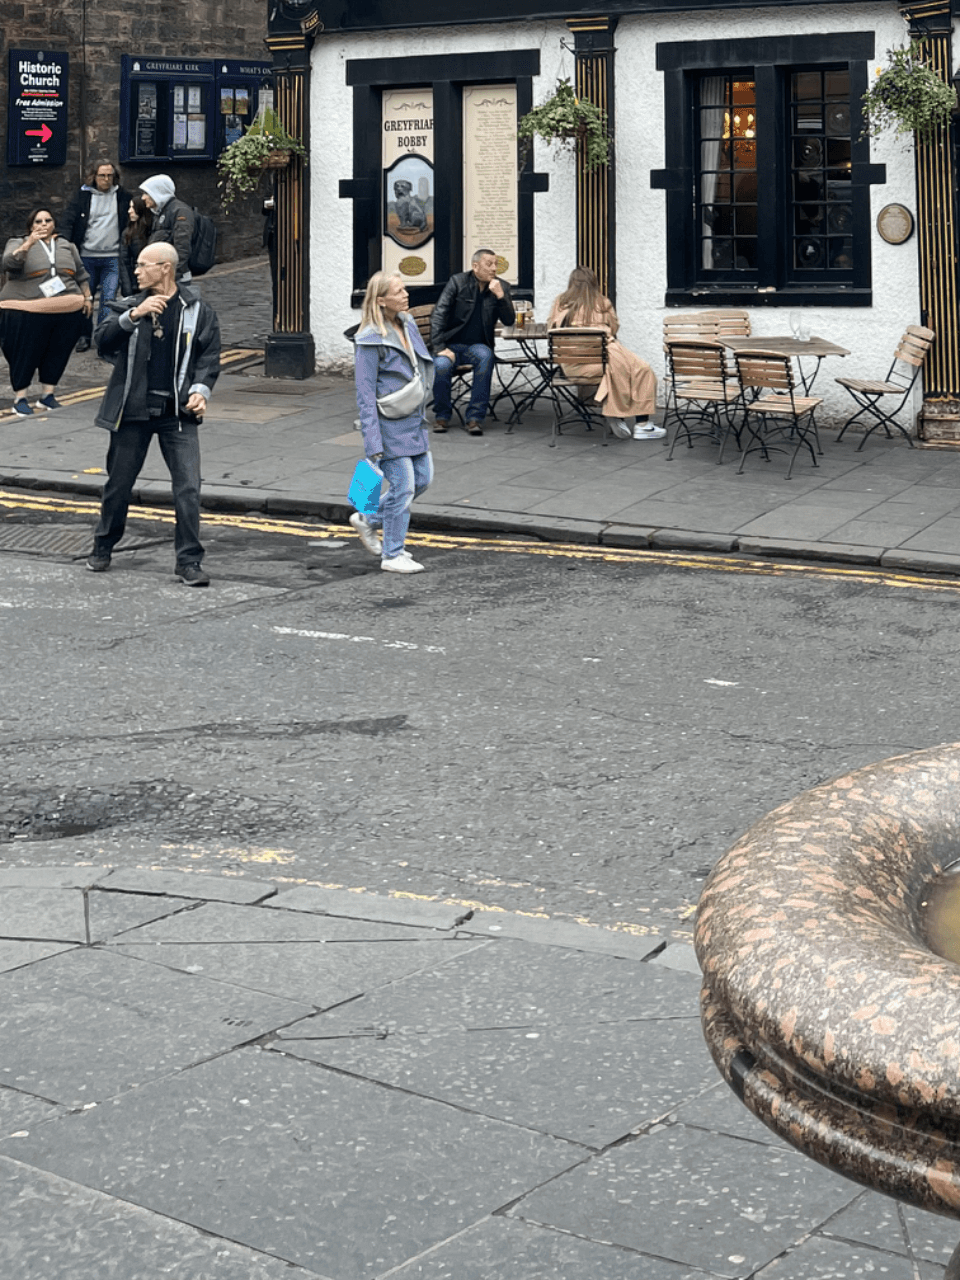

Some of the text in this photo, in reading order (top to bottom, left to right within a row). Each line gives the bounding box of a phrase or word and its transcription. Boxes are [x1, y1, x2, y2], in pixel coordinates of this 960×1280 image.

[18, 61, 62, 75] Historic
[145, 61, 200, 72] GREYFRIARS KIRK
[20, 74, 60, 87] Church
[15, 98, 64, 107] Free Admission
[397, 135, 428, 148] BOBBY
